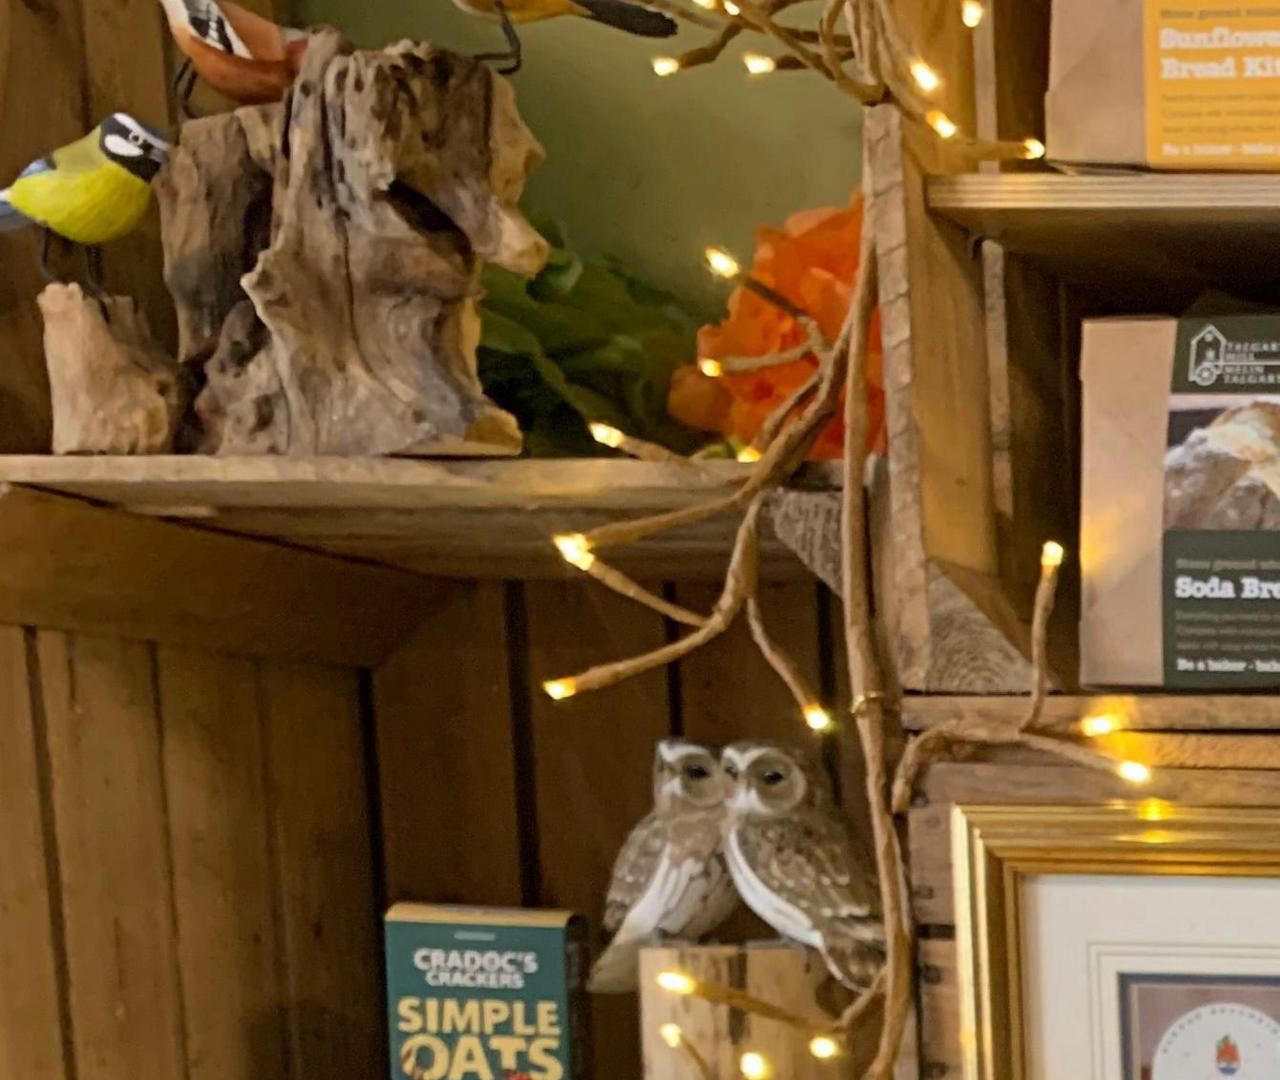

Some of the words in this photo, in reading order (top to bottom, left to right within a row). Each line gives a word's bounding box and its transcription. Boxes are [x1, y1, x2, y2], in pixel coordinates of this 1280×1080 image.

[1161, 57, 1237, 79] Bread
[1175, 576, 1235, 598] Soda
[413, 947, 539, 974] CRADOC'S
[425, 969, 524, 989] CRACKERS
[397, 996, 561, 1036] SIMPLE
